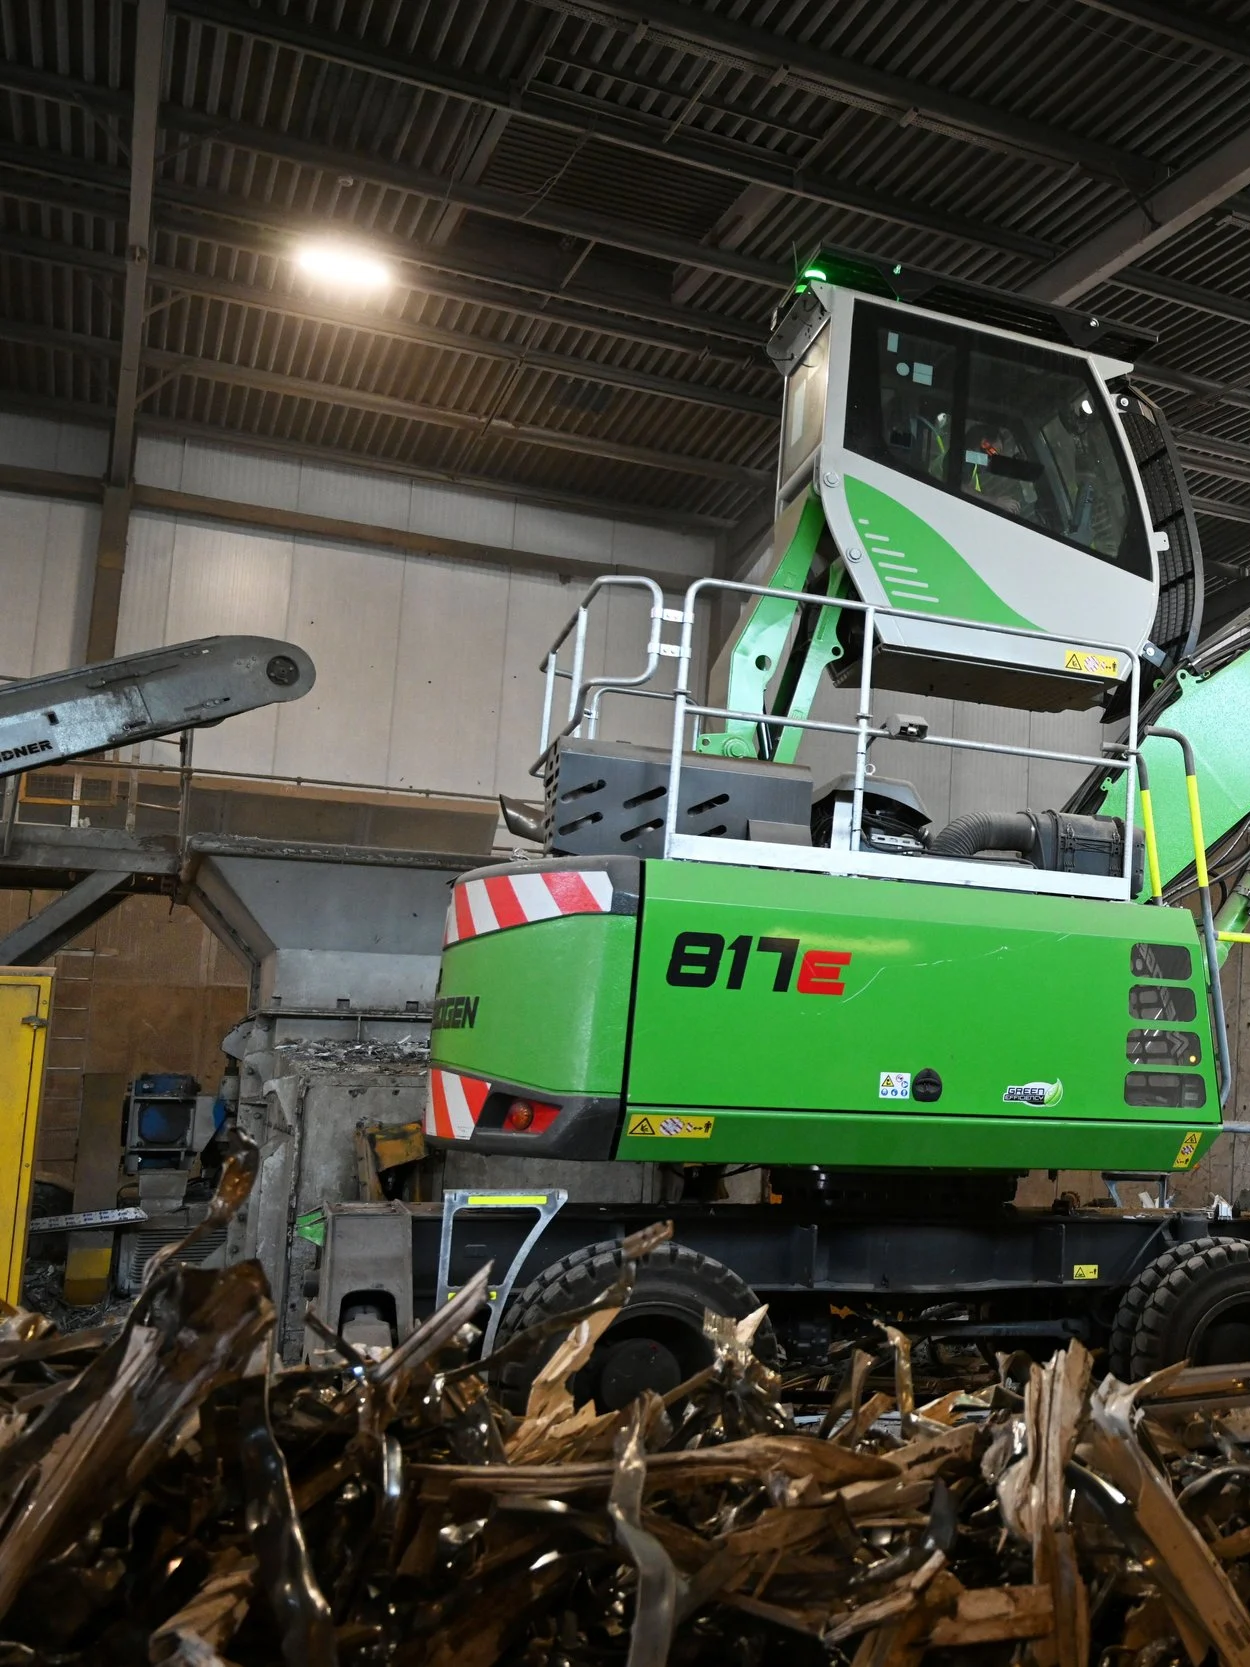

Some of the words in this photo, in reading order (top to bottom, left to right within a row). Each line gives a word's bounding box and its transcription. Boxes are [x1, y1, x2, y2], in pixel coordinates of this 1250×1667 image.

[0, 740, 53, 762] DNER
[665, 931, 853, 996] 817E
[433, 995, 480, 1029] OGEN
[1008, 1087, 1045, 1095] GREEN
